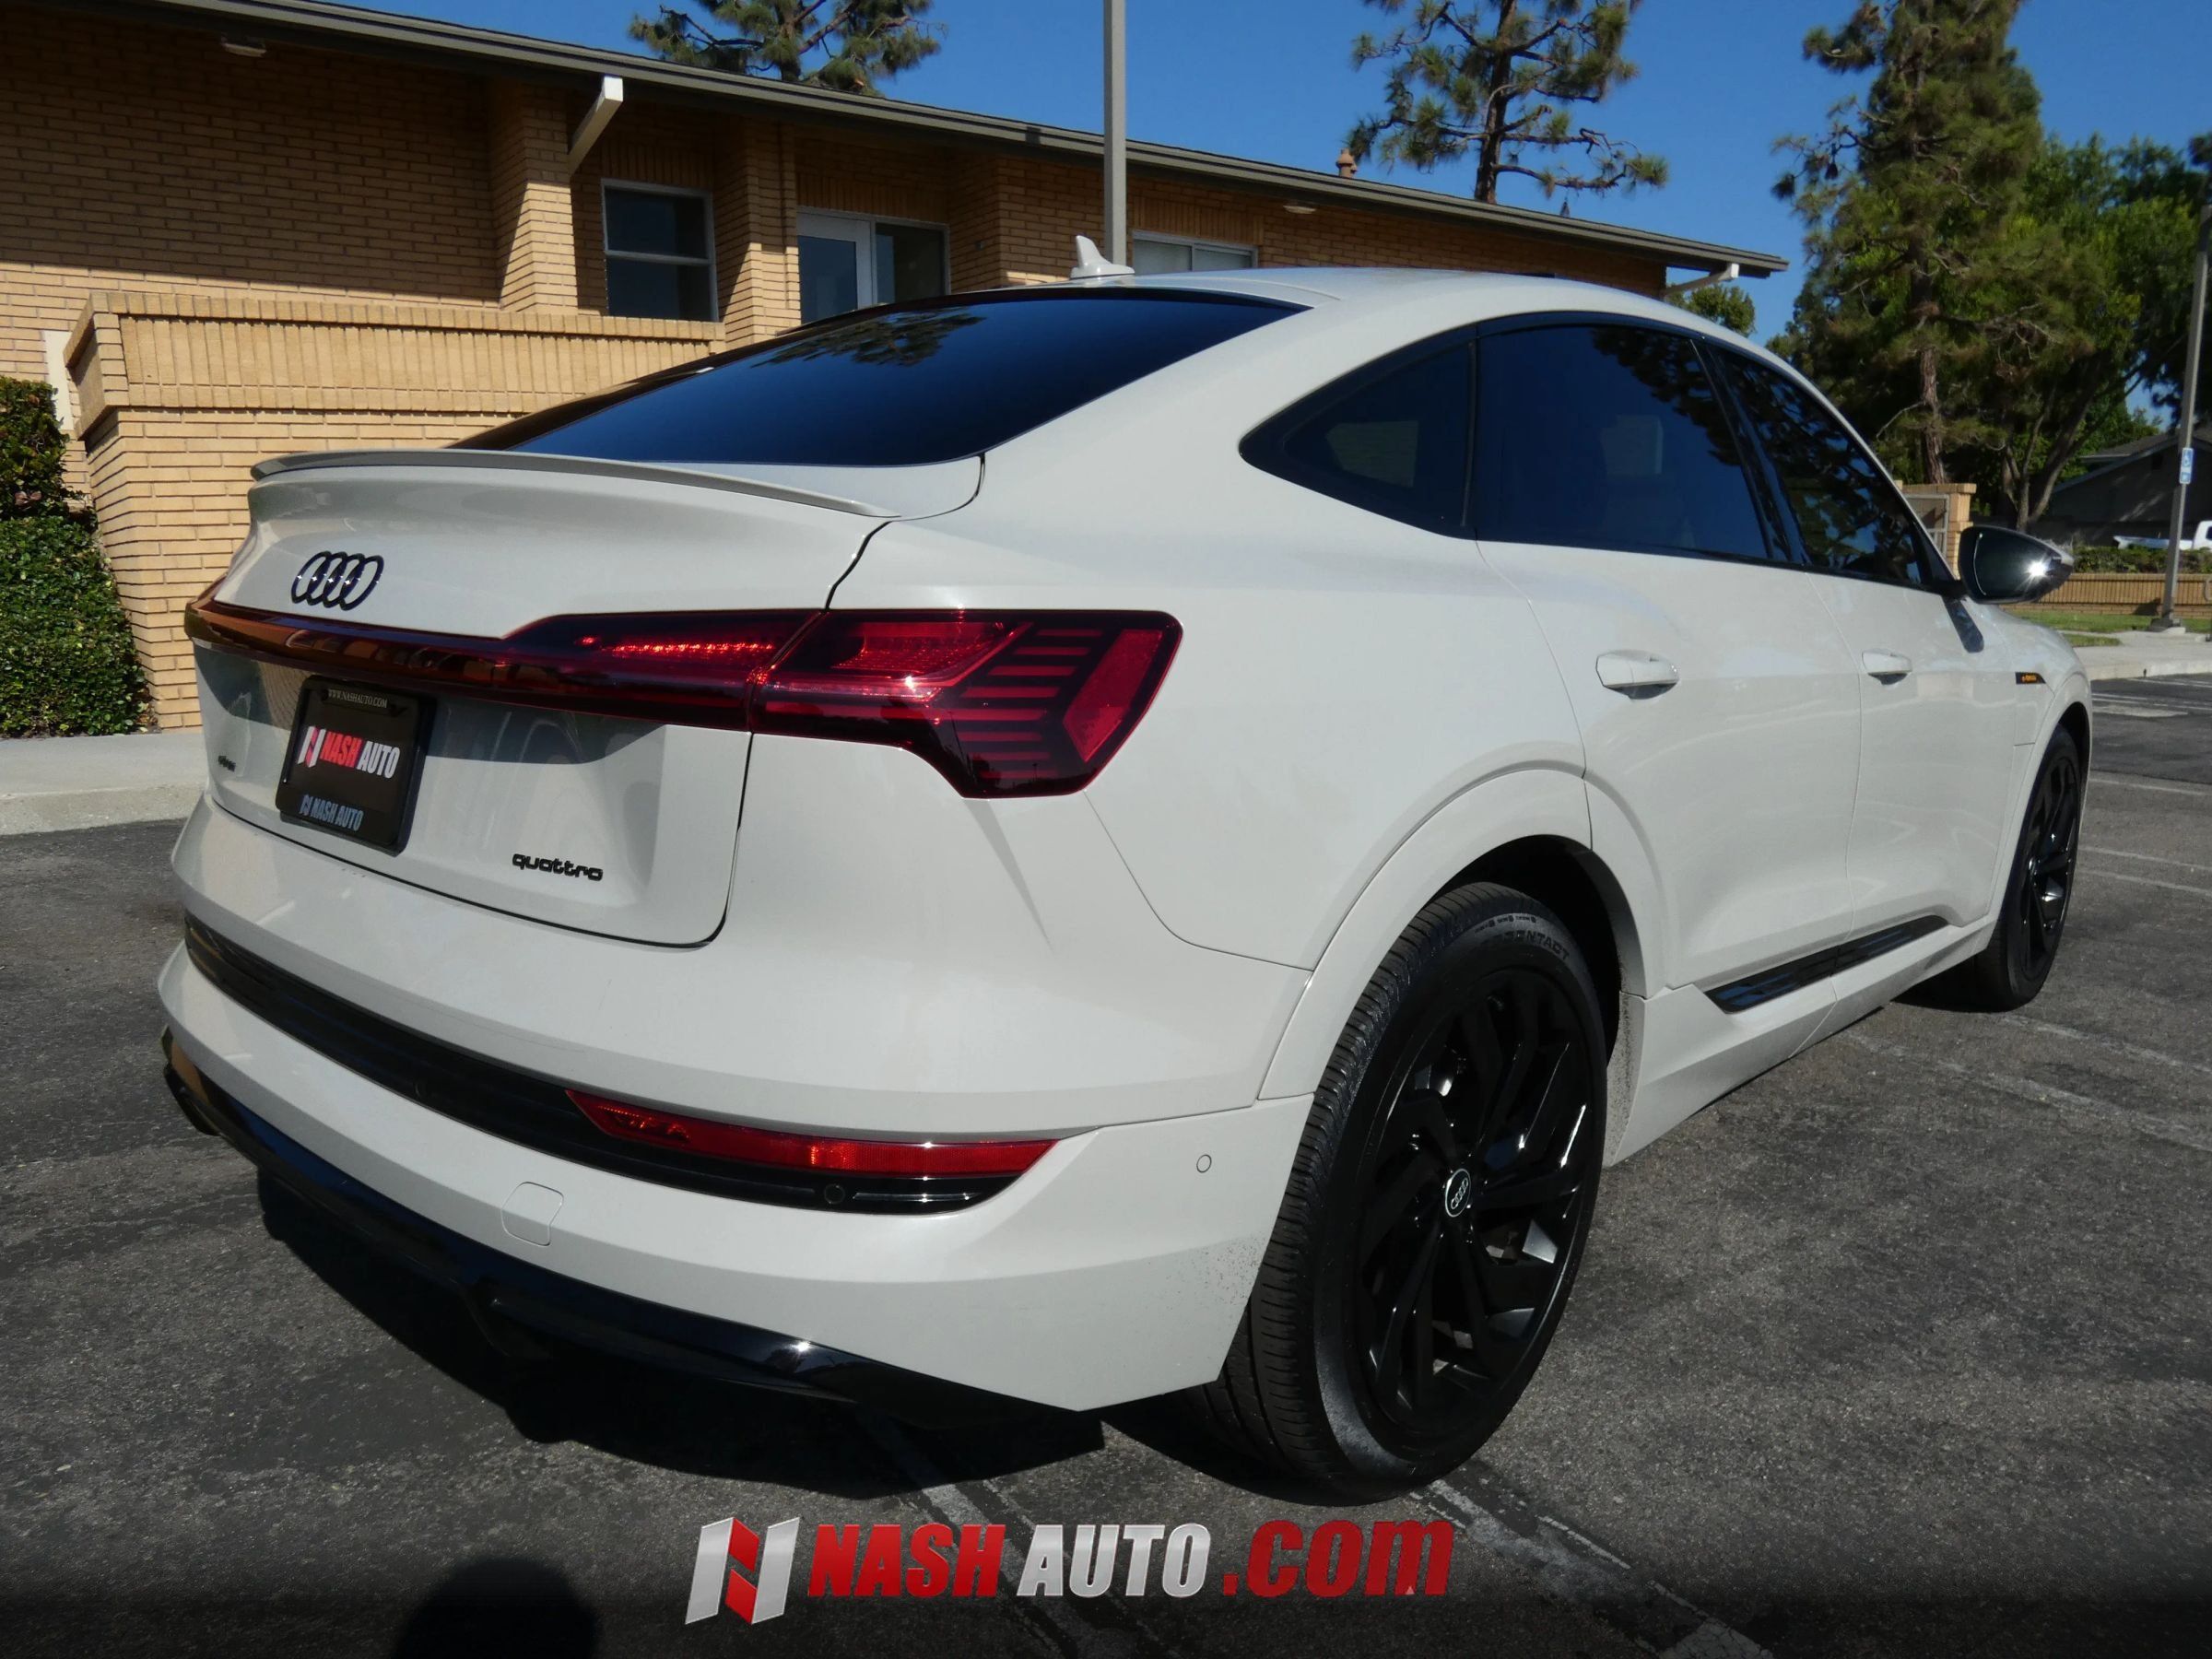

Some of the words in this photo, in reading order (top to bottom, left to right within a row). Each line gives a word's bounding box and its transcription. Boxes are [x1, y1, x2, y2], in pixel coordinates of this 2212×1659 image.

[320, 731, 363, 769] NASH
[356, 740, 400, 778] AUTO
[310, 798, 338, 823] NASH
[335, 806, 364, 831] AUTO
[512, 853, 604, 881] quattro
